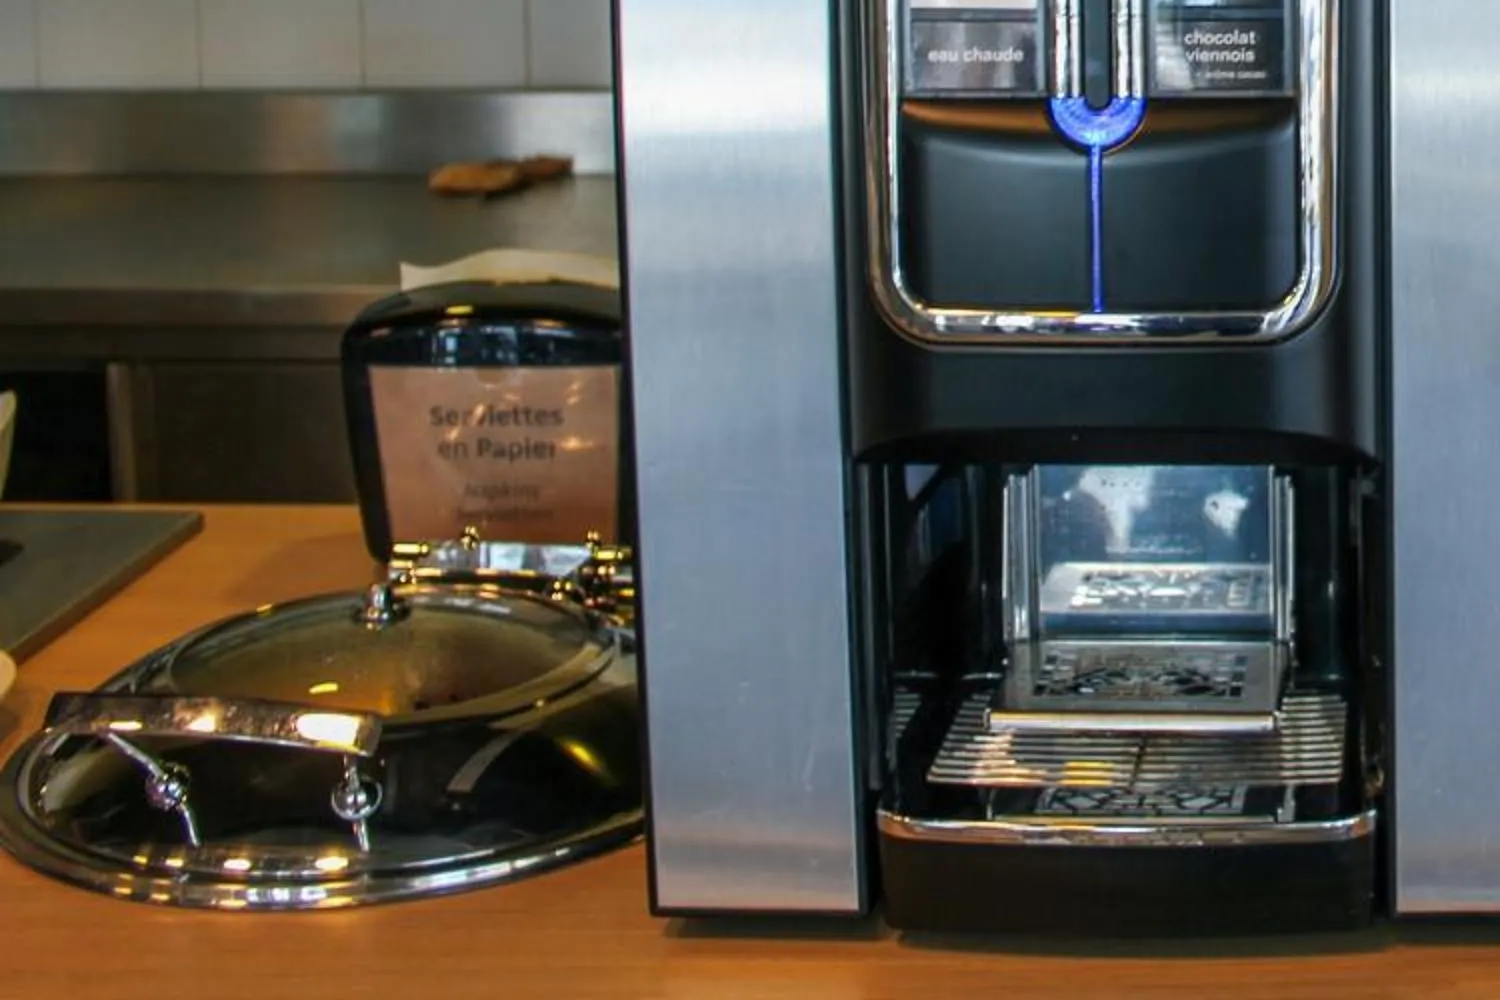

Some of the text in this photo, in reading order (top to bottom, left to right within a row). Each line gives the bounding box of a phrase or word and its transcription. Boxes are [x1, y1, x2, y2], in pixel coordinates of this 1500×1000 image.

[1184, 28, 1256, 45] chocolat
[928, 46, 1024, 62] eau chaude
[1185, 47, 1255, 62] viennois
[437, 440, 469, 460] en
